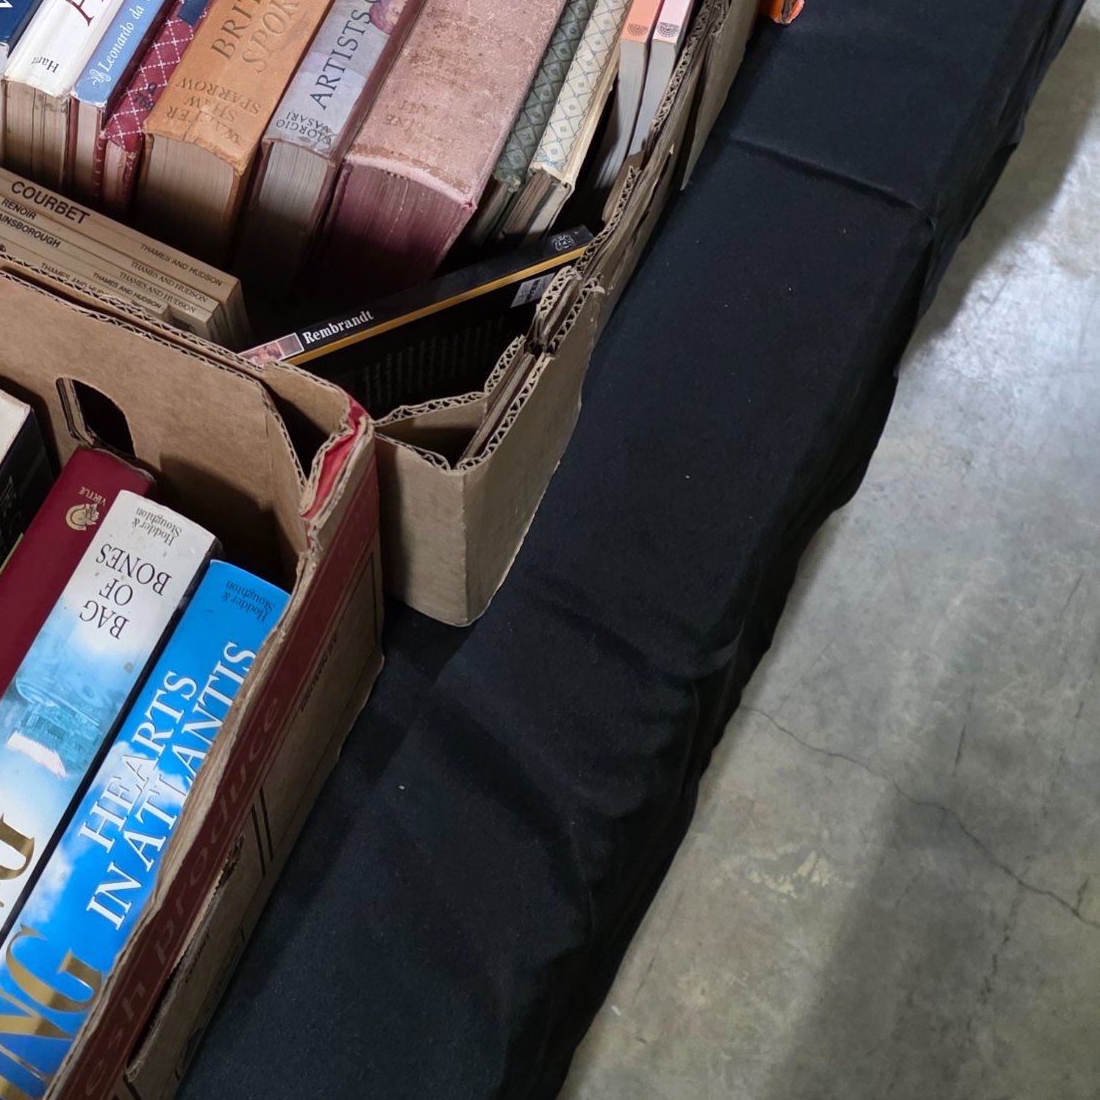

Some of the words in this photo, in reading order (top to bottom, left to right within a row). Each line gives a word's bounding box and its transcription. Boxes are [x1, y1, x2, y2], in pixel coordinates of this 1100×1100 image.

[97, 22, 135, 74] Leonardo
[308, 9, 373, 110] ARTISTS
[0, 198, 37, 220] RENOIR
[10, 179, 91, 225] COURBET
[139, 242, 170, 262] THAMES
[188, 265, 223, 287] HUDSON
[301, 309, 374, 346] Rembrandt
[95, 542, 173, 596] BONES
[99, 579, 133, 606] OF
[79, 601, 130, 640] BAG
[78, 670, 197, 855] HEARTS
[86, 862, 138, 931] IN
[129, 640, 258, 890] ATLANTIS
